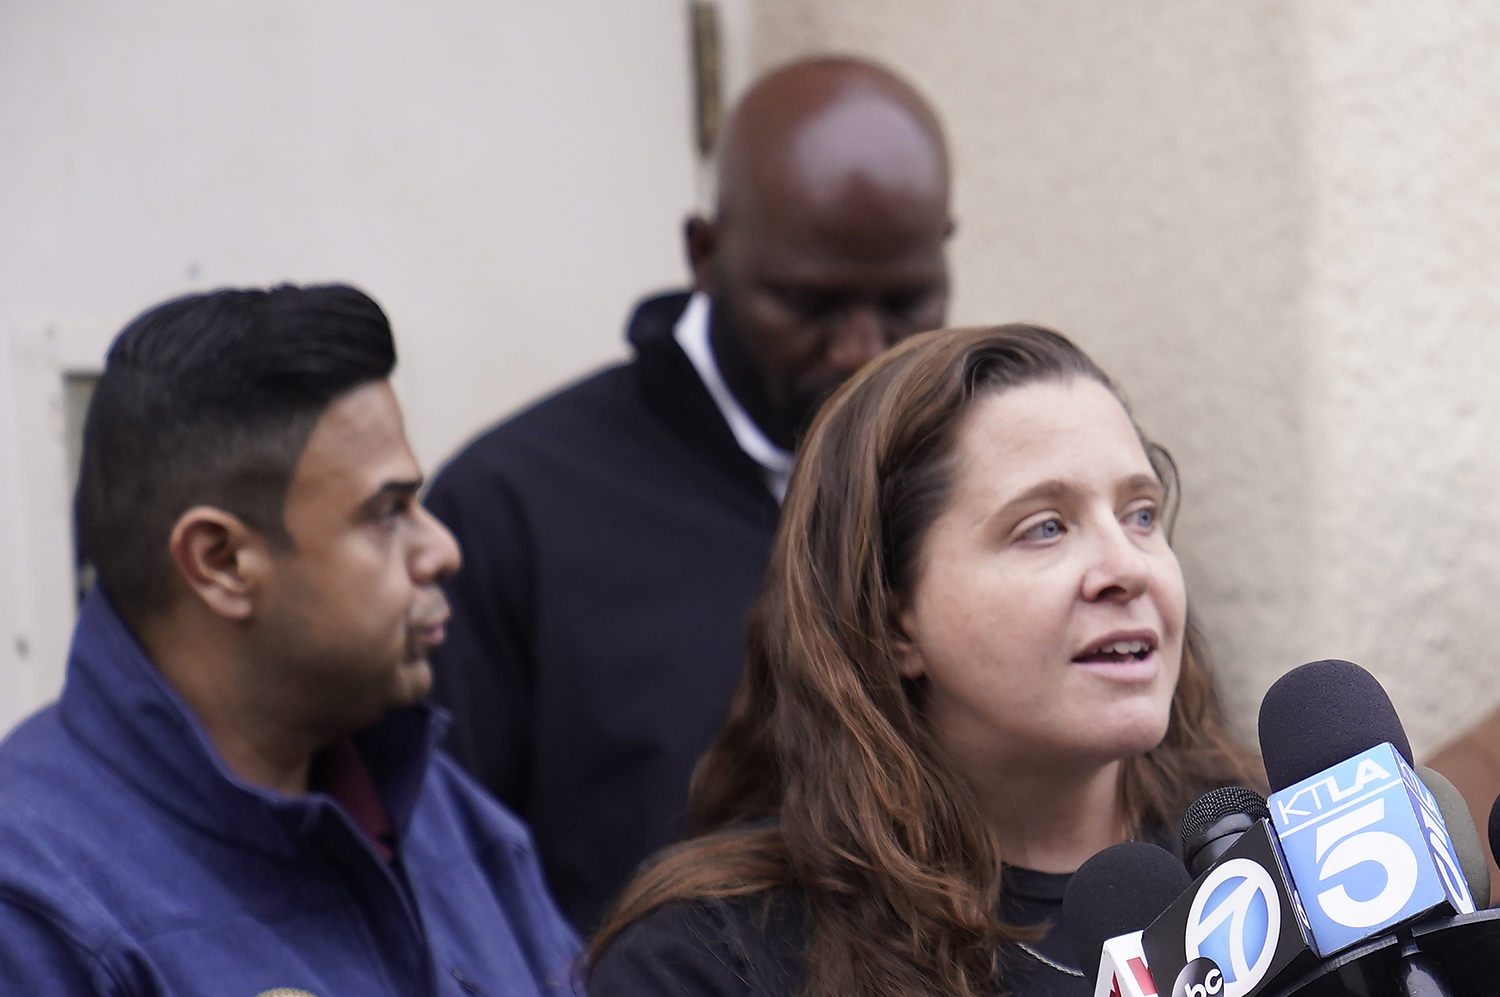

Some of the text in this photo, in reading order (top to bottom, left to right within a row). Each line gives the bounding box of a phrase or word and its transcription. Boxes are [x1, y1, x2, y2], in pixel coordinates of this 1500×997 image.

[1277, 758, 1391, 826] KTLA
[1316, 797, 1418, 928] 5
[1188, 862, 1272, 997] 7
